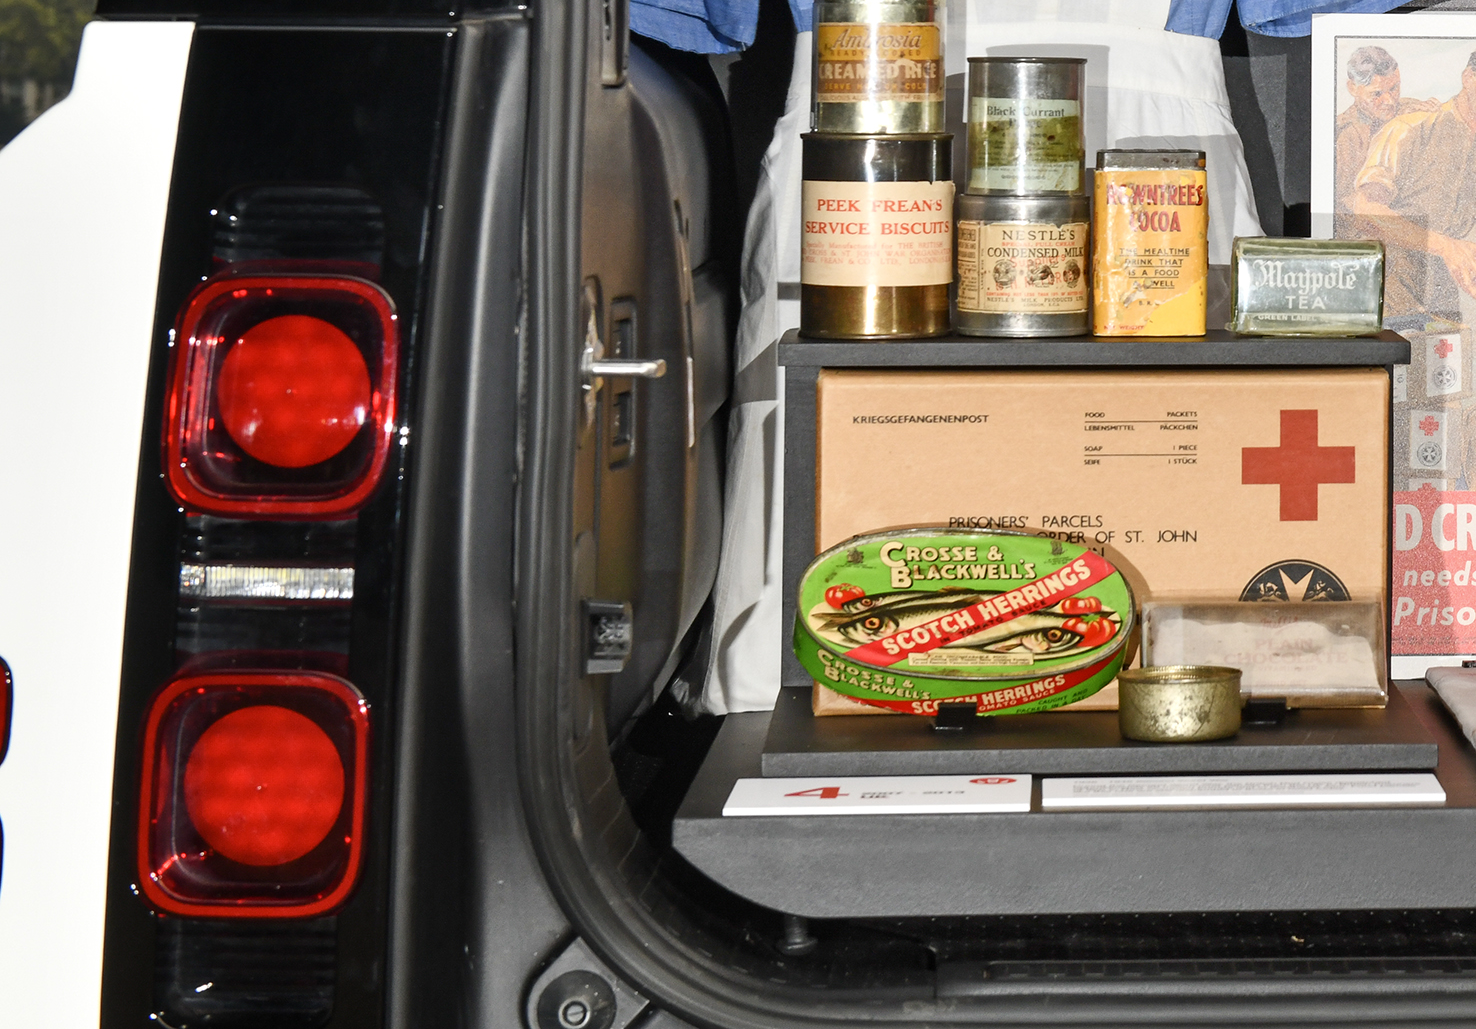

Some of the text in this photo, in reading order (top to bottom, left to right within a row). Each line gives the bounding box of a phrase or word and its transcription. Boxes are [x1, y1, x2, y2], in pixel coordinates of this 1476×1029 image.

[831, 28, 922, 50] Amrosia
[905, 62, 937, 79] RICE
[825, 82, 851, 90] SERVE
[987, 106, 1065, 117] Black Currant
[817, 199, 942, 212] PEEK FREAN'S
[1130, 210, 1181, 232] COCOA
[805, 221, 949, 235] SERVICE BISCUITS
[987, 247, 1084, 258] CONDENSED MILK
[1253, 259, 1360, 295] Maypole
[1285, 295, 1326, 310] TEA
[852, 414, 989, 424] KRIEGSGEFANGENENPOST
[949, 515, 1103, 528] PRISONERS' PARCELS
[1095, 531, 1115, 543] OF
[1125, 531, 1144, 543] ST.
[1157, 530, 1198, 543] JOHN
[987, 545, 1003, 561] &
[882, 559, 1091, 655] SCOTCH HERRINGS
[960, 617, 1004, 637] TOMATO
[1011, 600, 1047, 616] SAUCE
[1253, 638, 1314, 650] PLAIN
[1224, 652, 1348, 665] CHOCOLATE
[902, 679, 915, 689] &
[981, 674, 1066, 705] HERRINGS
[979, 689, 1055, 711] OMATO SAUCE
[1038, 695, 1067, 705] CAUGHT
[1016, 705, 1047, 713] PACKED
[784, 786, 849, 799] 4
